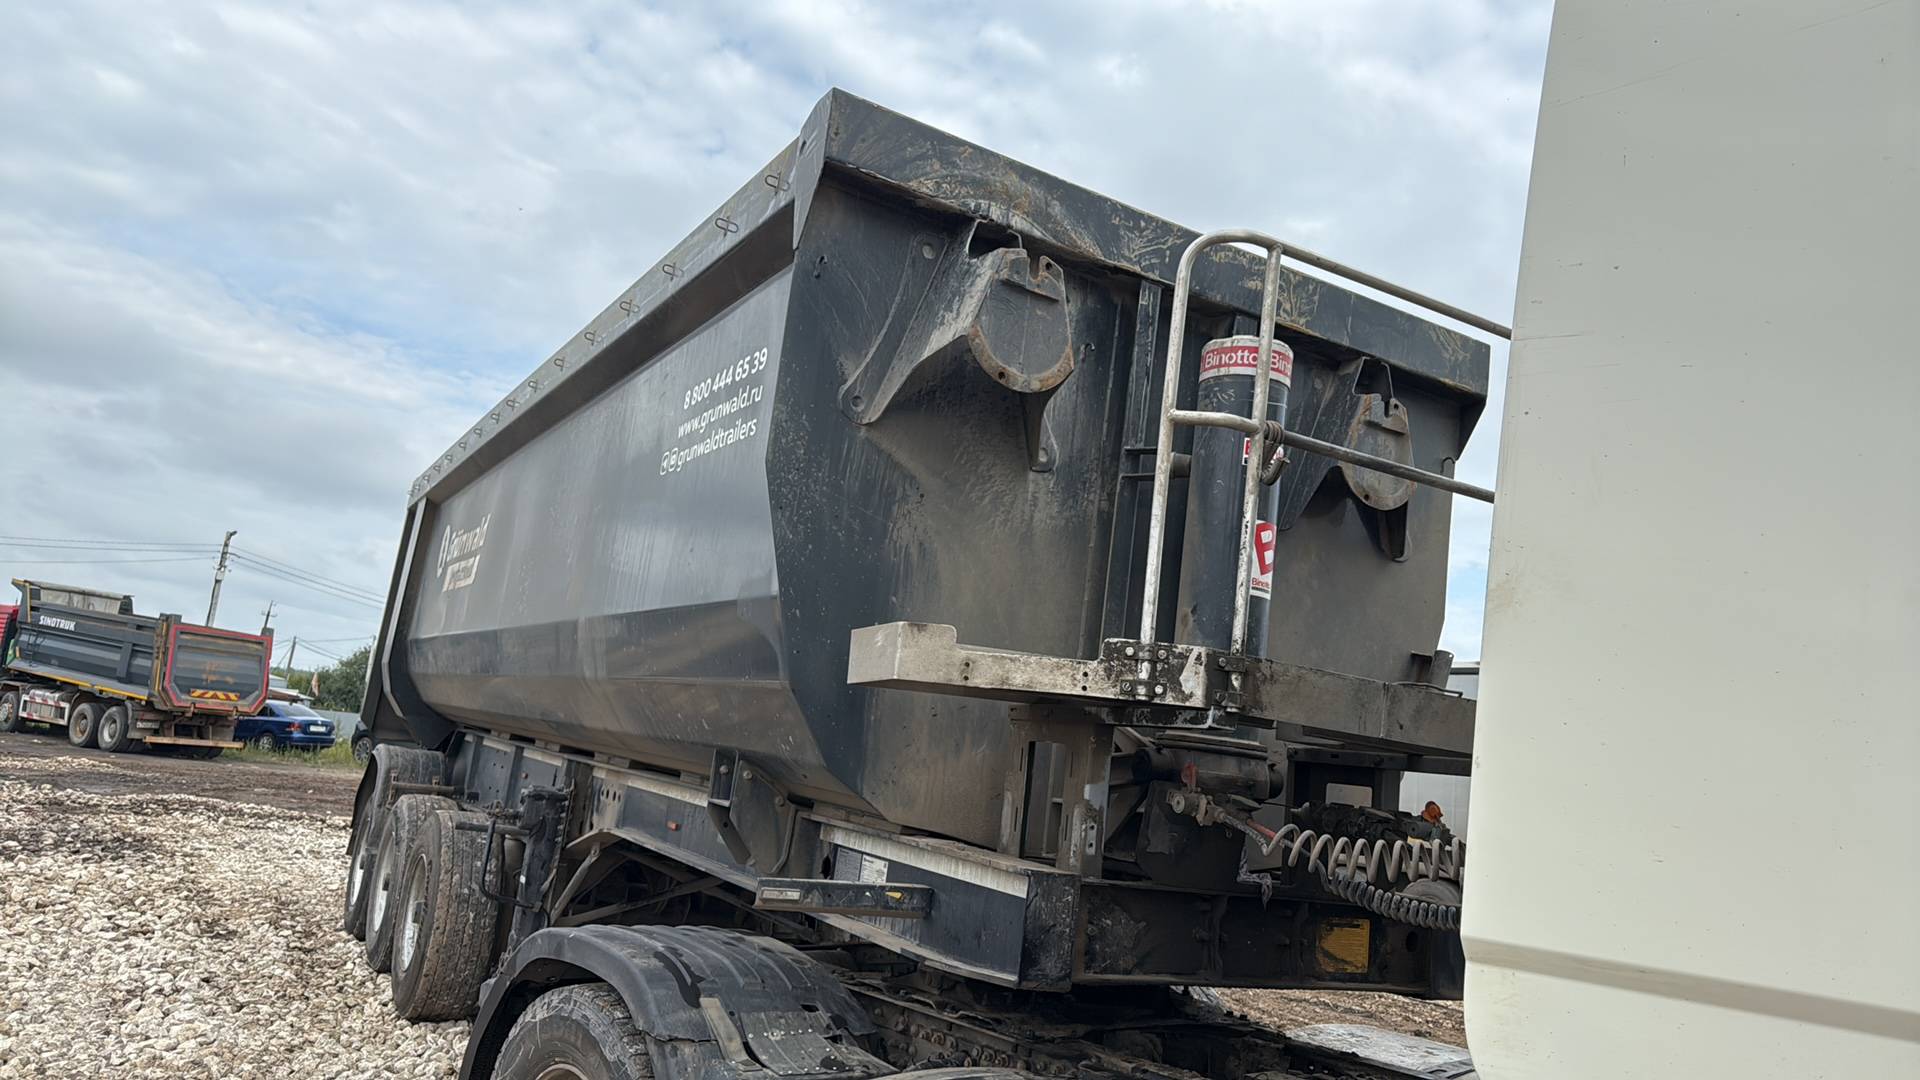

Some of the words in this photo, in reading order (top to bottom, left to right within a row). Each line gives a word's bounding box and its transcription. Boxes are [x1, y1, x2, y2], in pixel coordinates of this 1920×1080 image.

[1204, 349, 1259, 369] Binotto
[683, 390, 691, 410] 8
[691, 378, 712, 405] 800
[712, 365, 734, 392] 444
[735, 355, 751, 382] 65
[751, 347, 768, 374] 39
[678, 385, 764, 438] www.grunwald.ru
[39, 615, 76, 631] SINOTRUK
